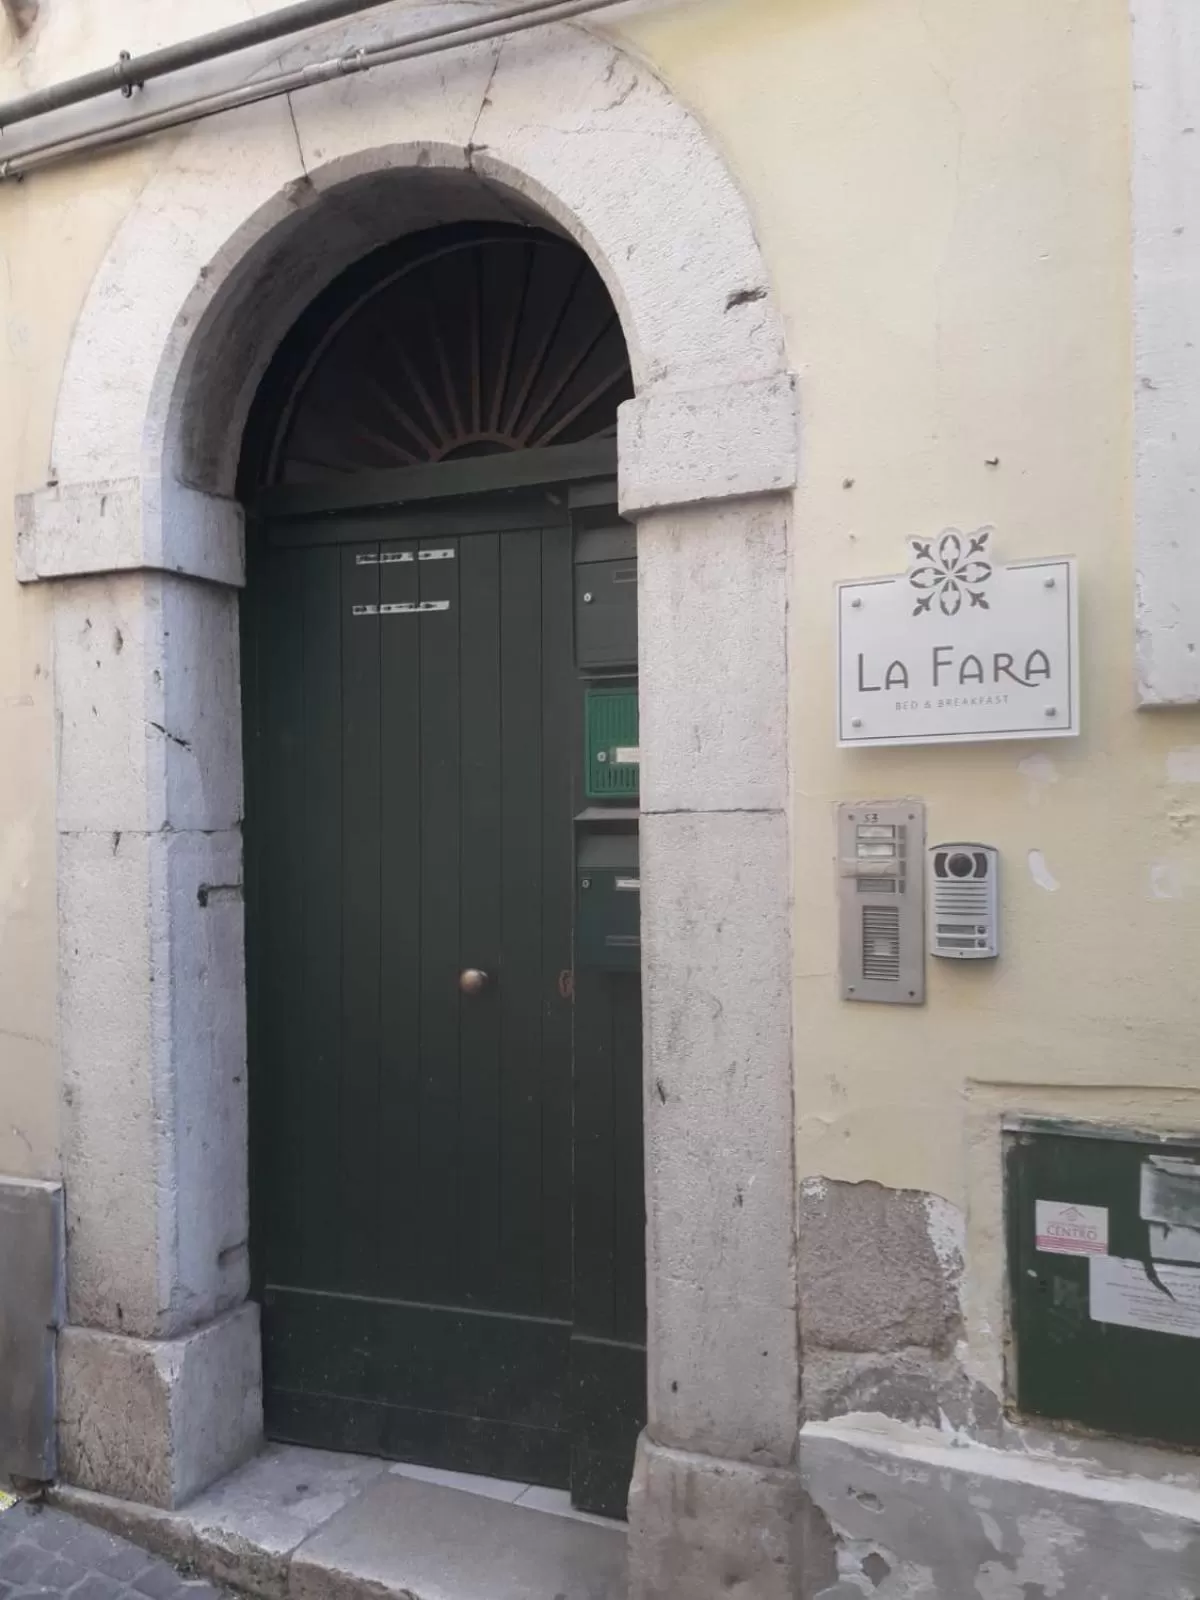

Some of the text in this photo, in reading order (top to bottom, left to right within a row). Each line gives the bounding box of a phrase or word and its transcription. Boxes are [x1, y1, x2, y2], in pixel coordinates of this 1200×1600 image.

[858, 646, 1050, 691] LA FARA
[895, 694, 1009, 711] BED & BREAKFAST
[1046, 1224, 1098, 1241] CENTRO
